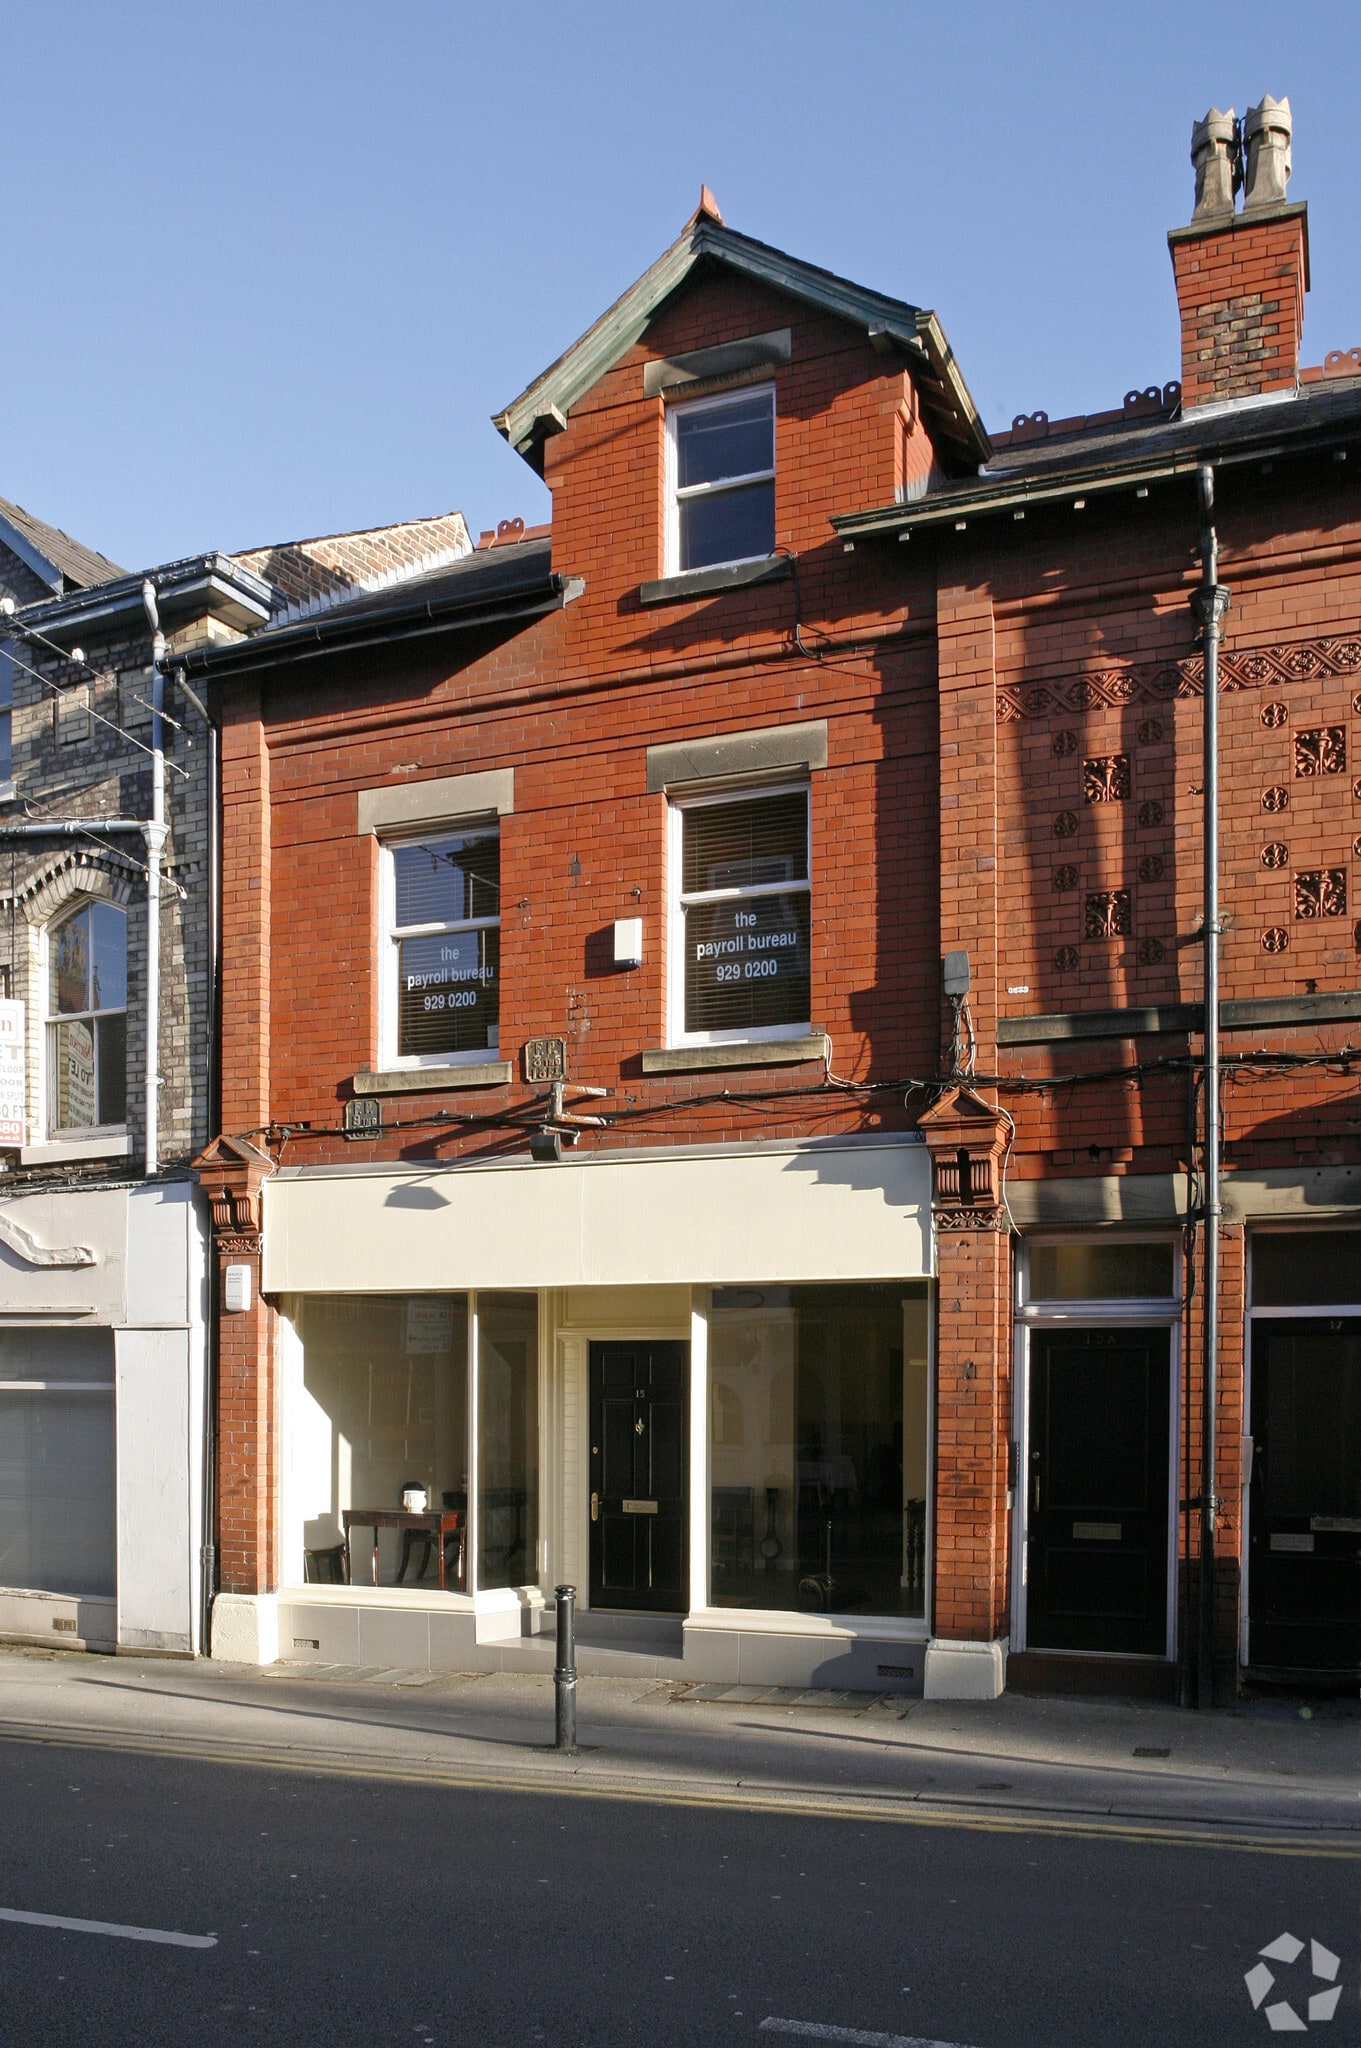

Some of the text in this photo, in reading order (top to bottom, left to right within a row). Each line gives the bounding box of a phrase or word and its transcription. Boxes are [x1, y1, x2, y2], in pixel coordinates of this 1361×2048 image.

[735, 911, 757, 928] the
[440, 946, 460, 961] the
[696, 932, 797, 961] payroll bureau
[407, 965, 494, 991] payroll bureau
[716, 959, 777, 981] 929 0200
[424, 990, 477, 1011] 929 0200
[636, 1389, 646, 1398] 15
